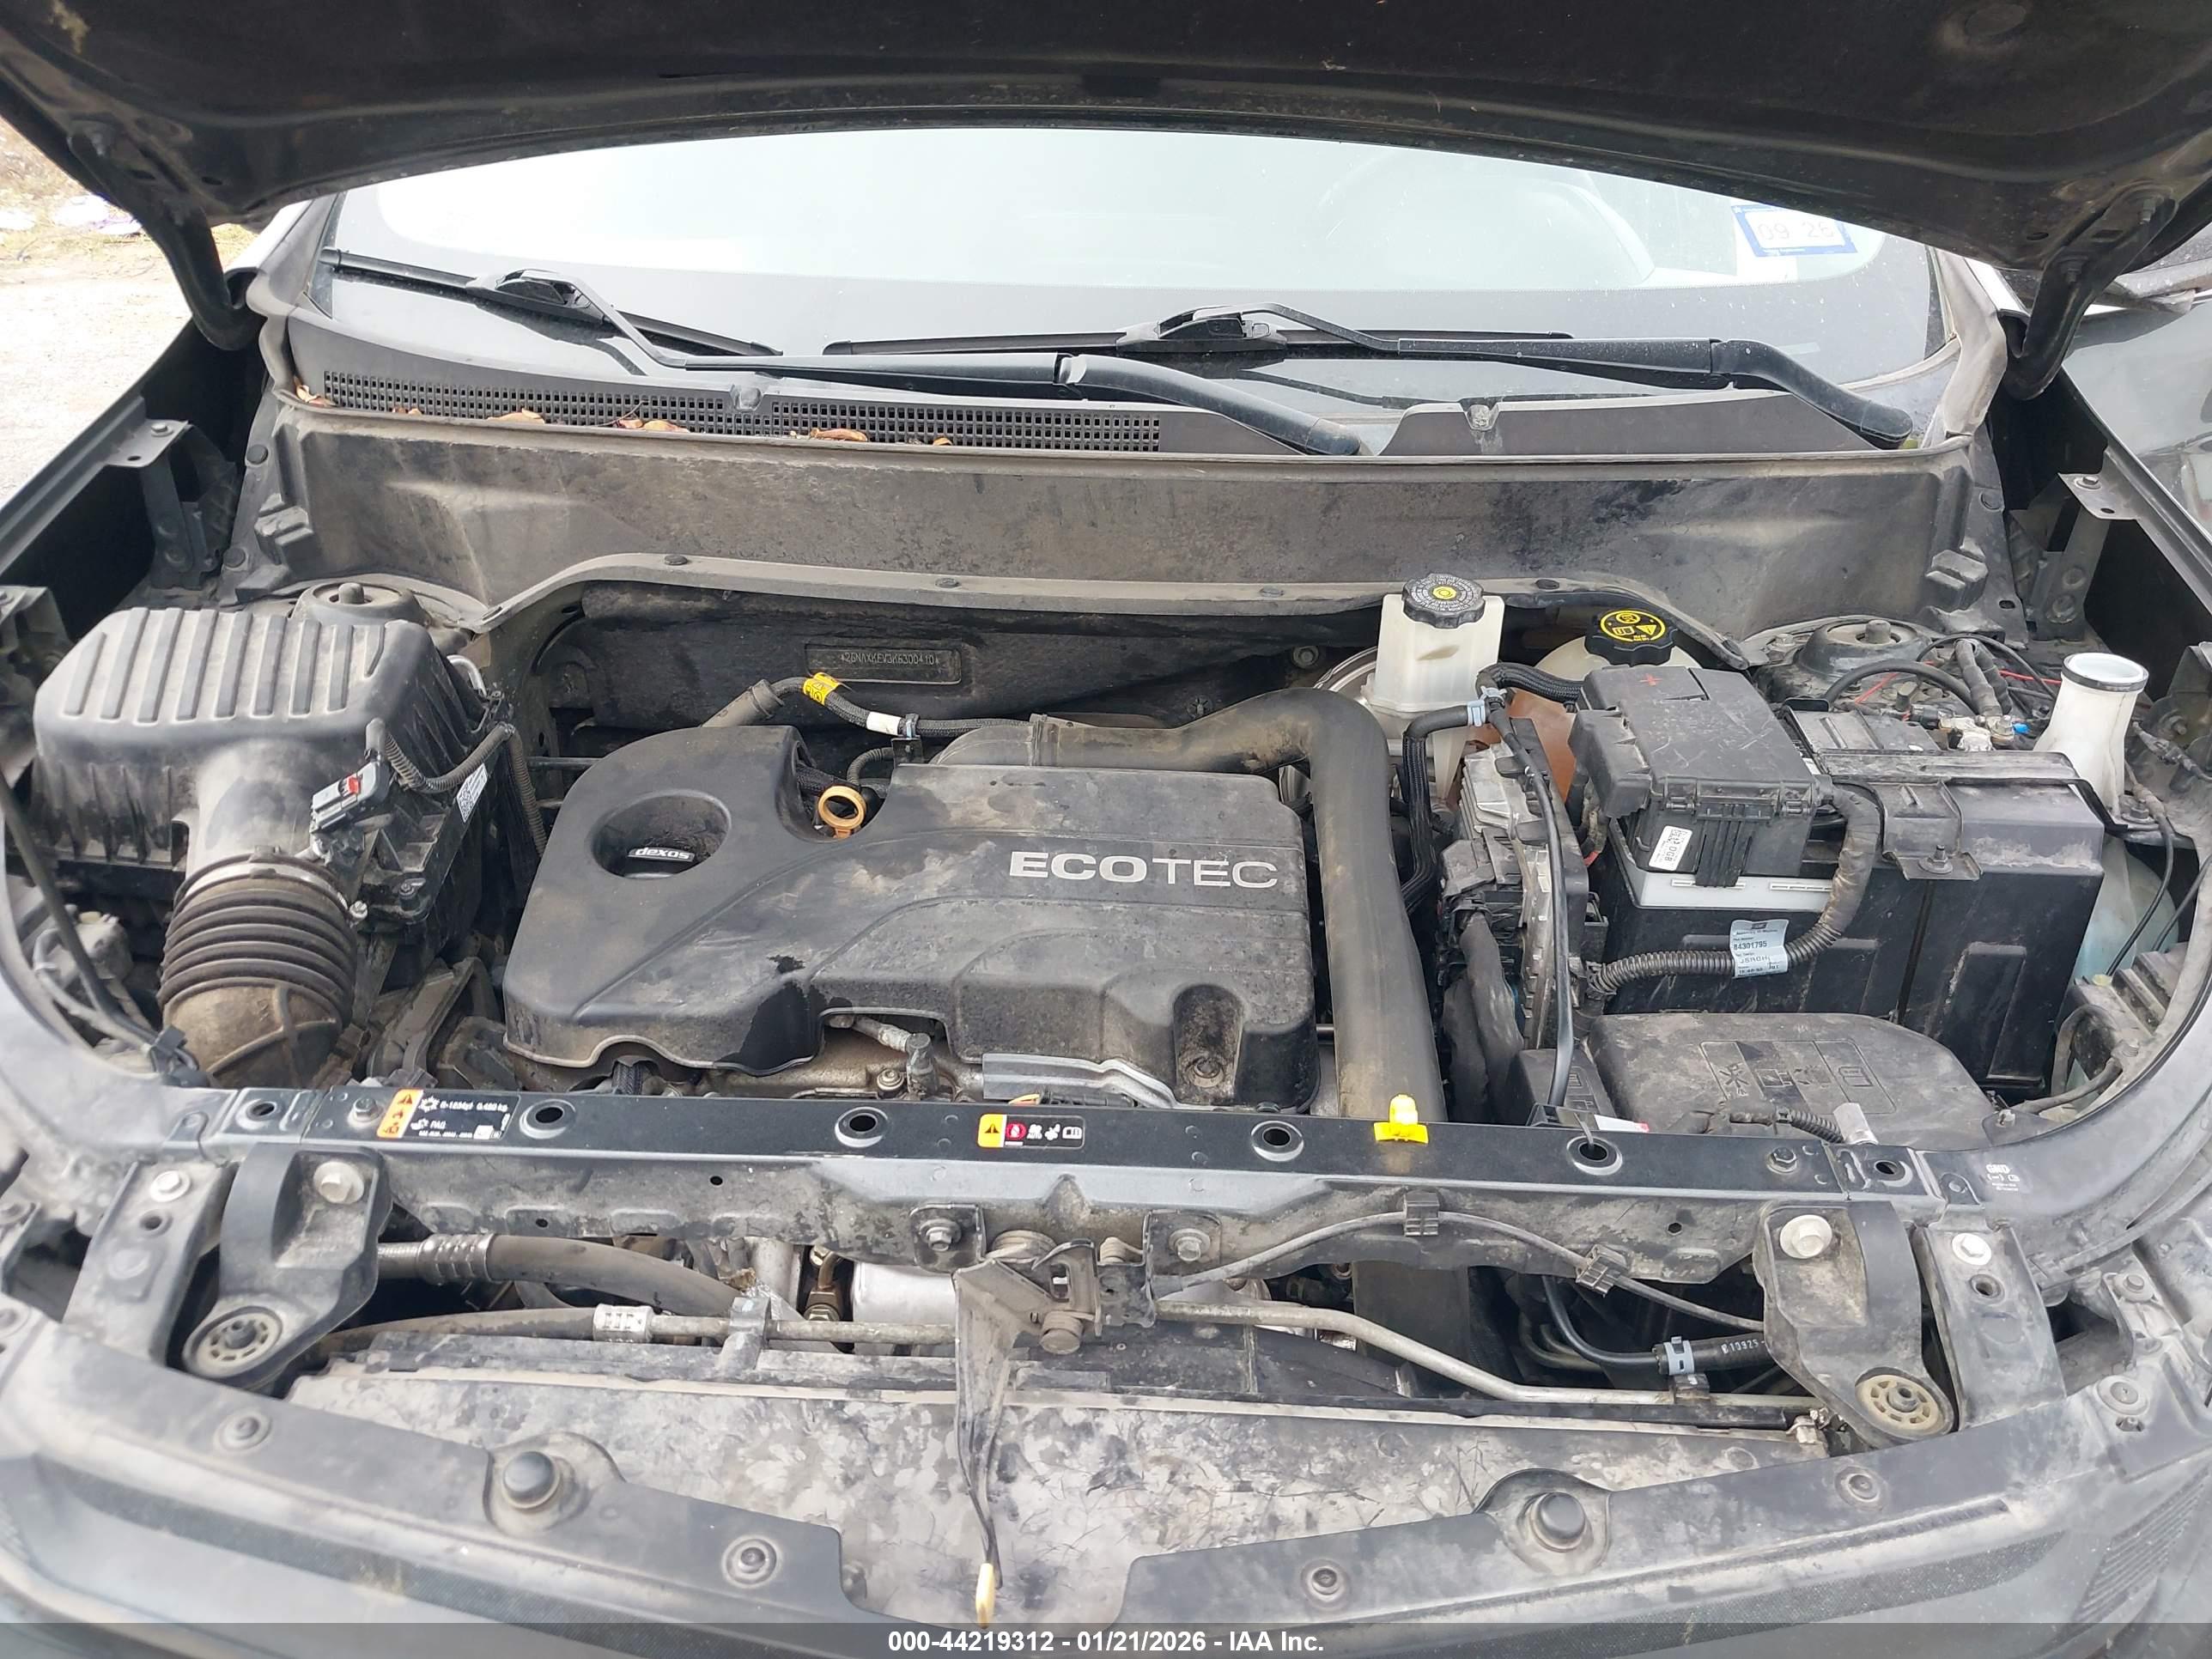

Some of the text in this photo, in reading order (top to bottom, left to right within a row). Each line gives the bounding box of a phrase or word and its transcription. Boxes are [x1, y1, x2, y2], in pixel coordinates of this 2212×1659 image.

[1758, 223, 1790, 240] 09
[635, 847, 690, 859] dexos
[1010, 851, 1278, 889] ECOTEC
